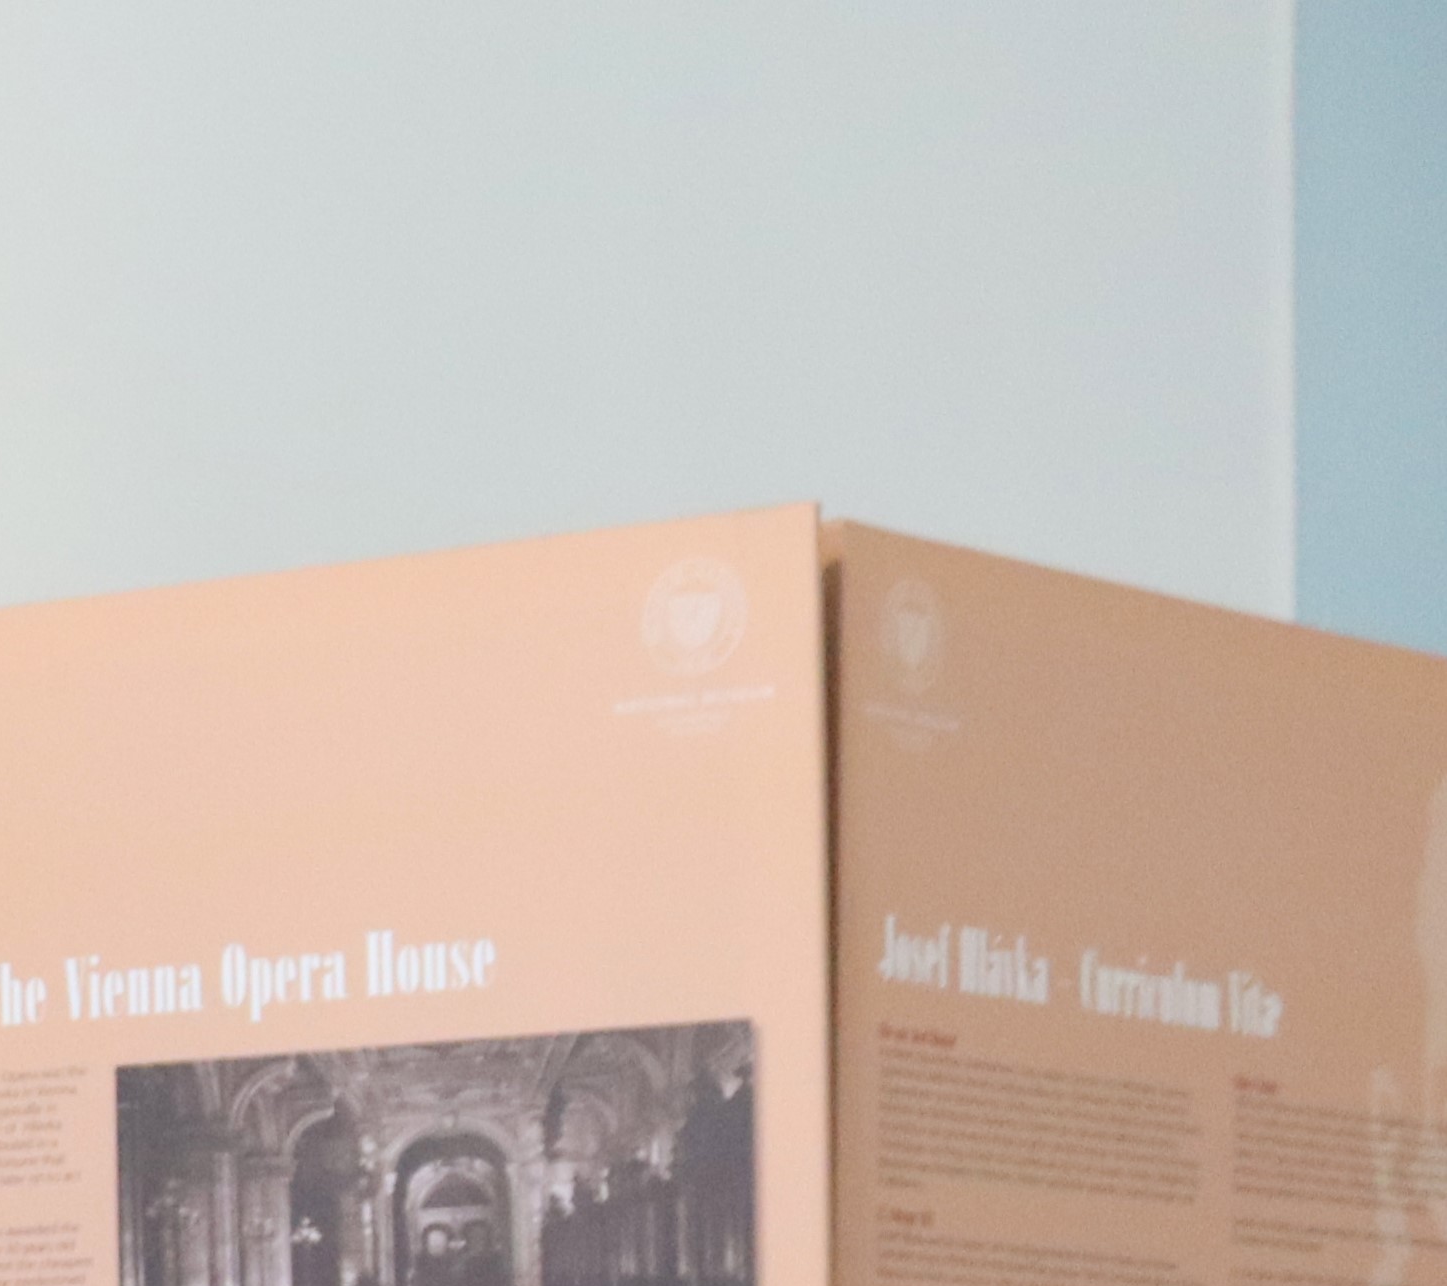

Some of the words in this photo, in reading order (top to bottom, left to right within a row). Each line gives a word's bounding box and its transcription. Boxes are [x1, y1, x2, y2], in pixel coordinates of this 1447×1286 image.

[64, 953, 204, 1022] Vienna
[220, 942, 349, 1024] Opera
[365, 928, 497, 998] House
[878, 912, 951, 989] Josef
